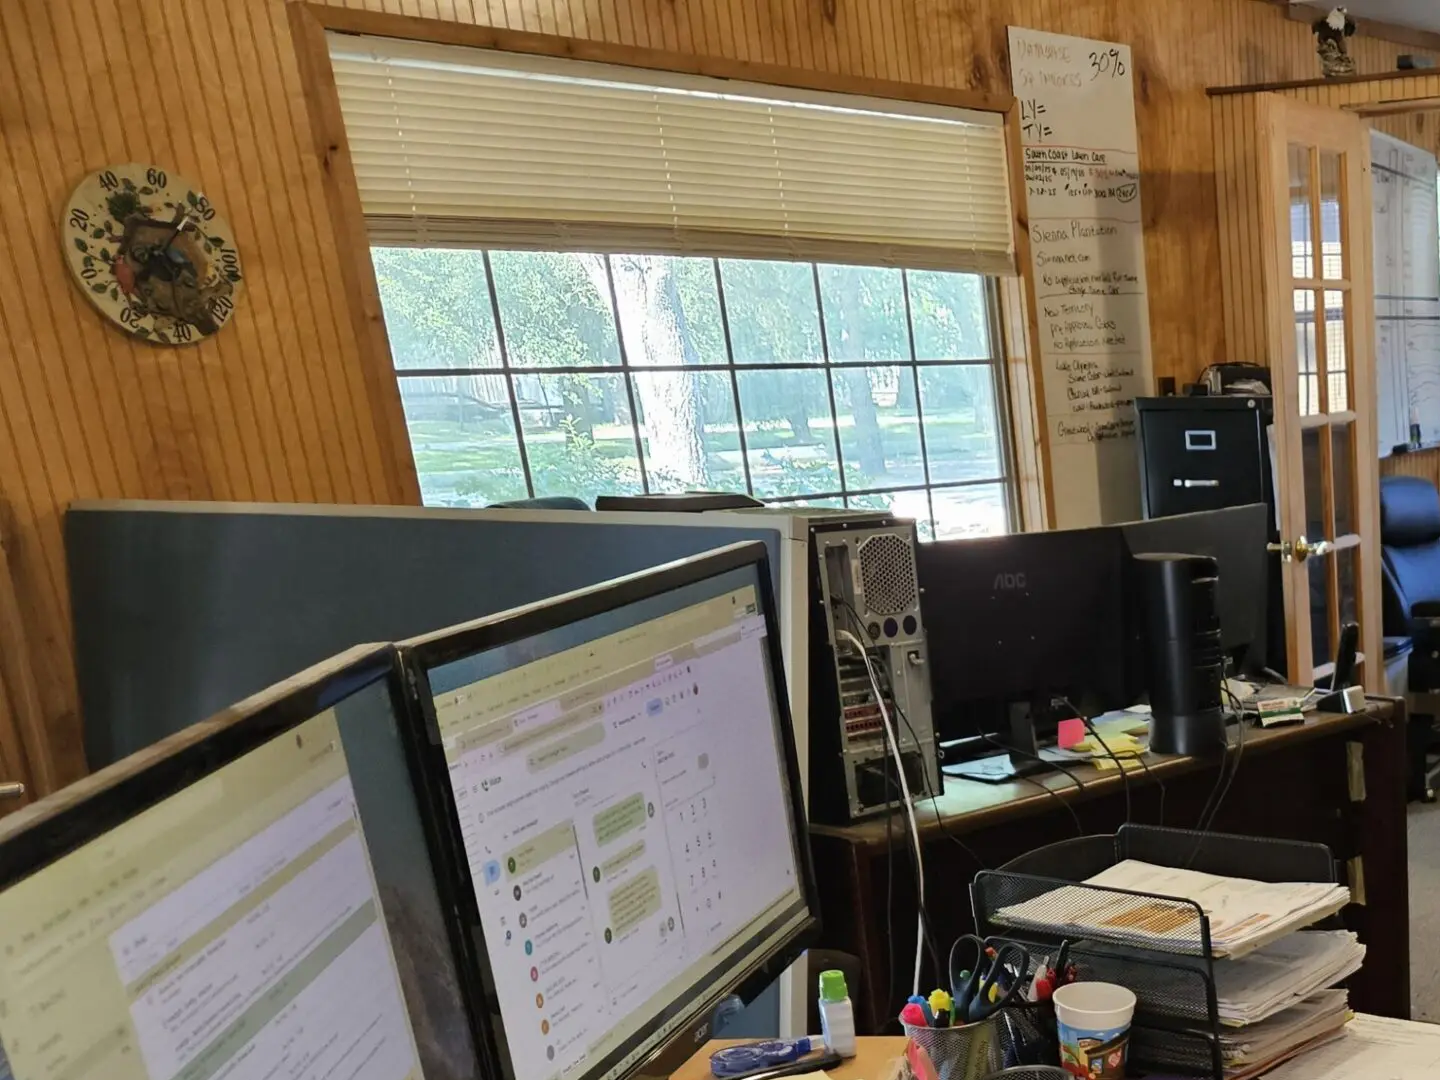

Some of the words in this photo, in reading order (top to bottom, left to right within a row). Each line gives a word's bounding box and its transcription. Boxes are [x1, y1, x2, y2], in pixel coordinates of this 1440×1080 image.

[1089, 48, 1125, 81] 30%
[1020, 98, 1047, 120] LY=
[1022, 123, 1053, 143] TY=
[99, 170, 119, 192] 40
[146, 168, 168, 189] 60
[195, 196, 216, 221] 80
[69, 208, 90, 233] 20
[80, 268, 97, 280] 0
[221, 248, 241, 278] 100
[212, 295, 235, 323] 120
